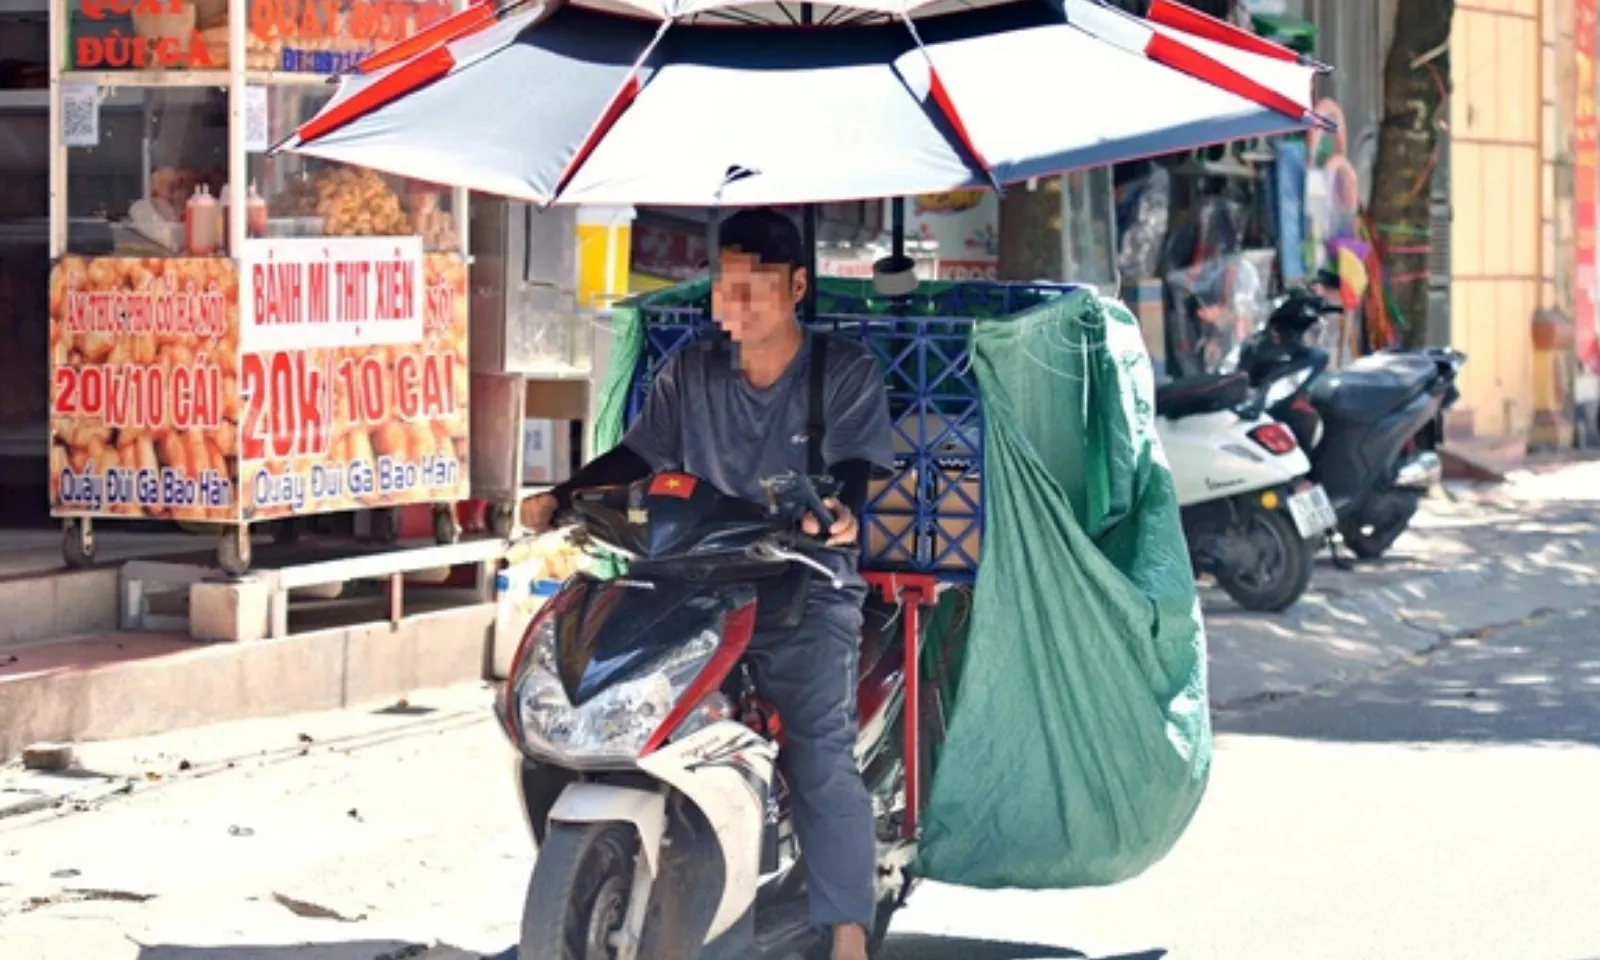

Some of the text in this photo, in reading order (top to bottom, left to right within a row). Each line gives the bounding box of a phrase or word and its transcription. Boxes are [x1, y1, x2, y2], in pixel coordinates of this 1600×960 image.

[253, 246, 414, 336] BÁNH MÌ THỊT XIÊN
[174, 354, 218, 426] CÁI
[399, 342, 454, 419] CÁI
